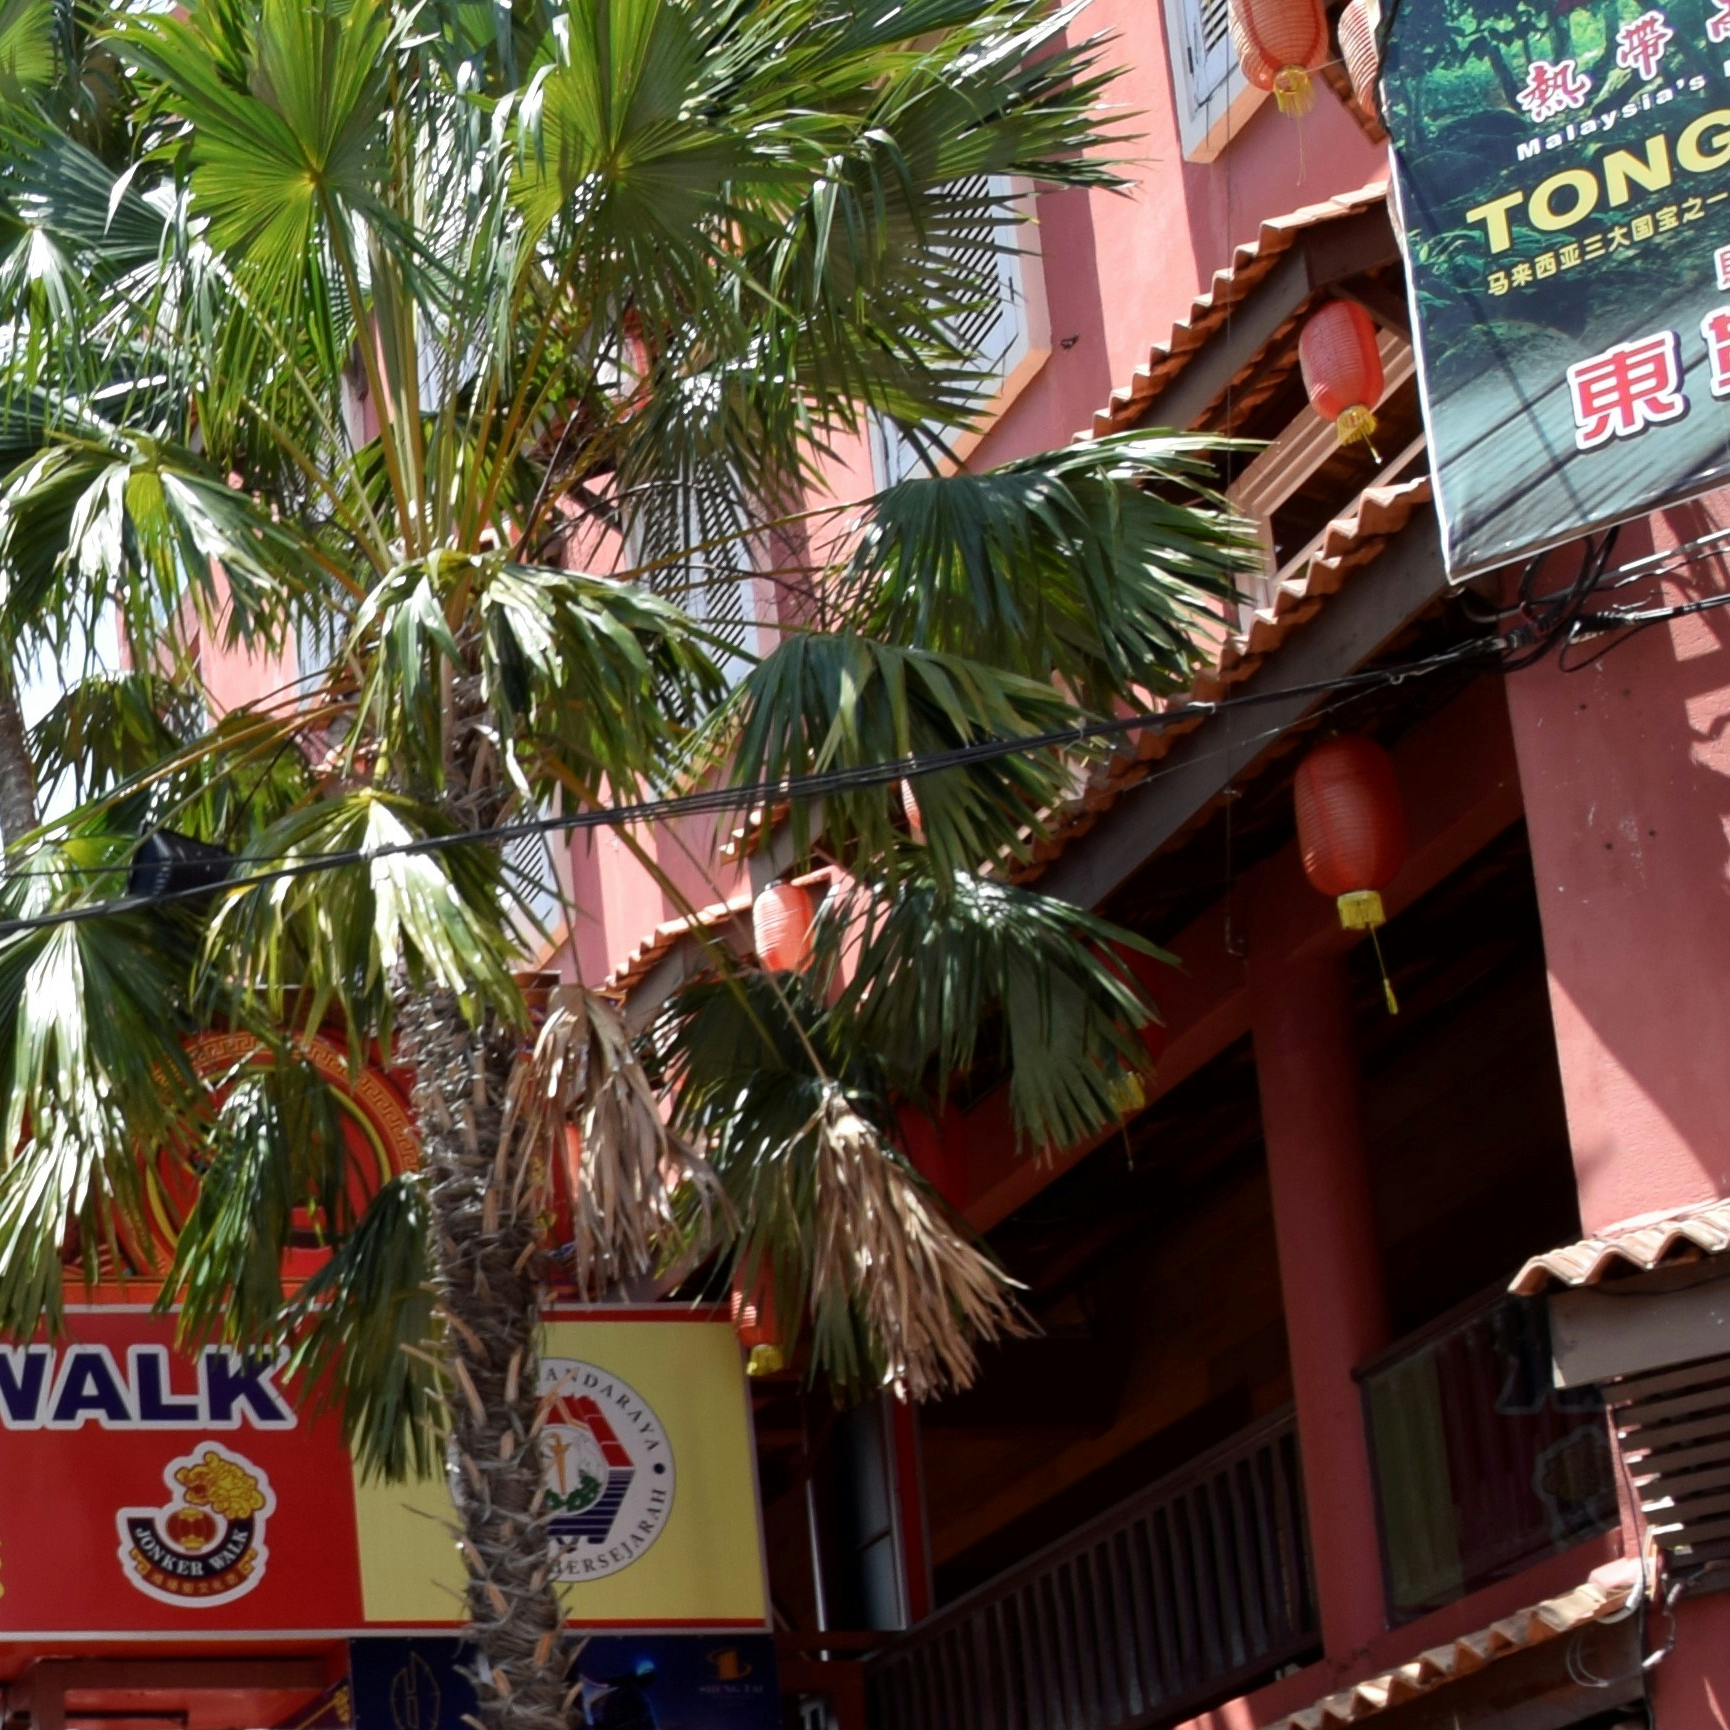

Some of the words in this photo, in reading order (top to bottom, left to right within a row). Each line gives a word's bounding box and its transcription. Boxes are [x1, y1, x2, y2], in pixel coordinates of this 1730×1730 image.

[1516, 72, 1706, 163] Malaysia's
[1487, 192, 1729, 297] 马来西亚三大国宝之一
[542, 1367, 661, 1452] ANDARAYA
[135, 1527, 206, 1577] JONKER
[208, 1528, 249, 1571] WALK
